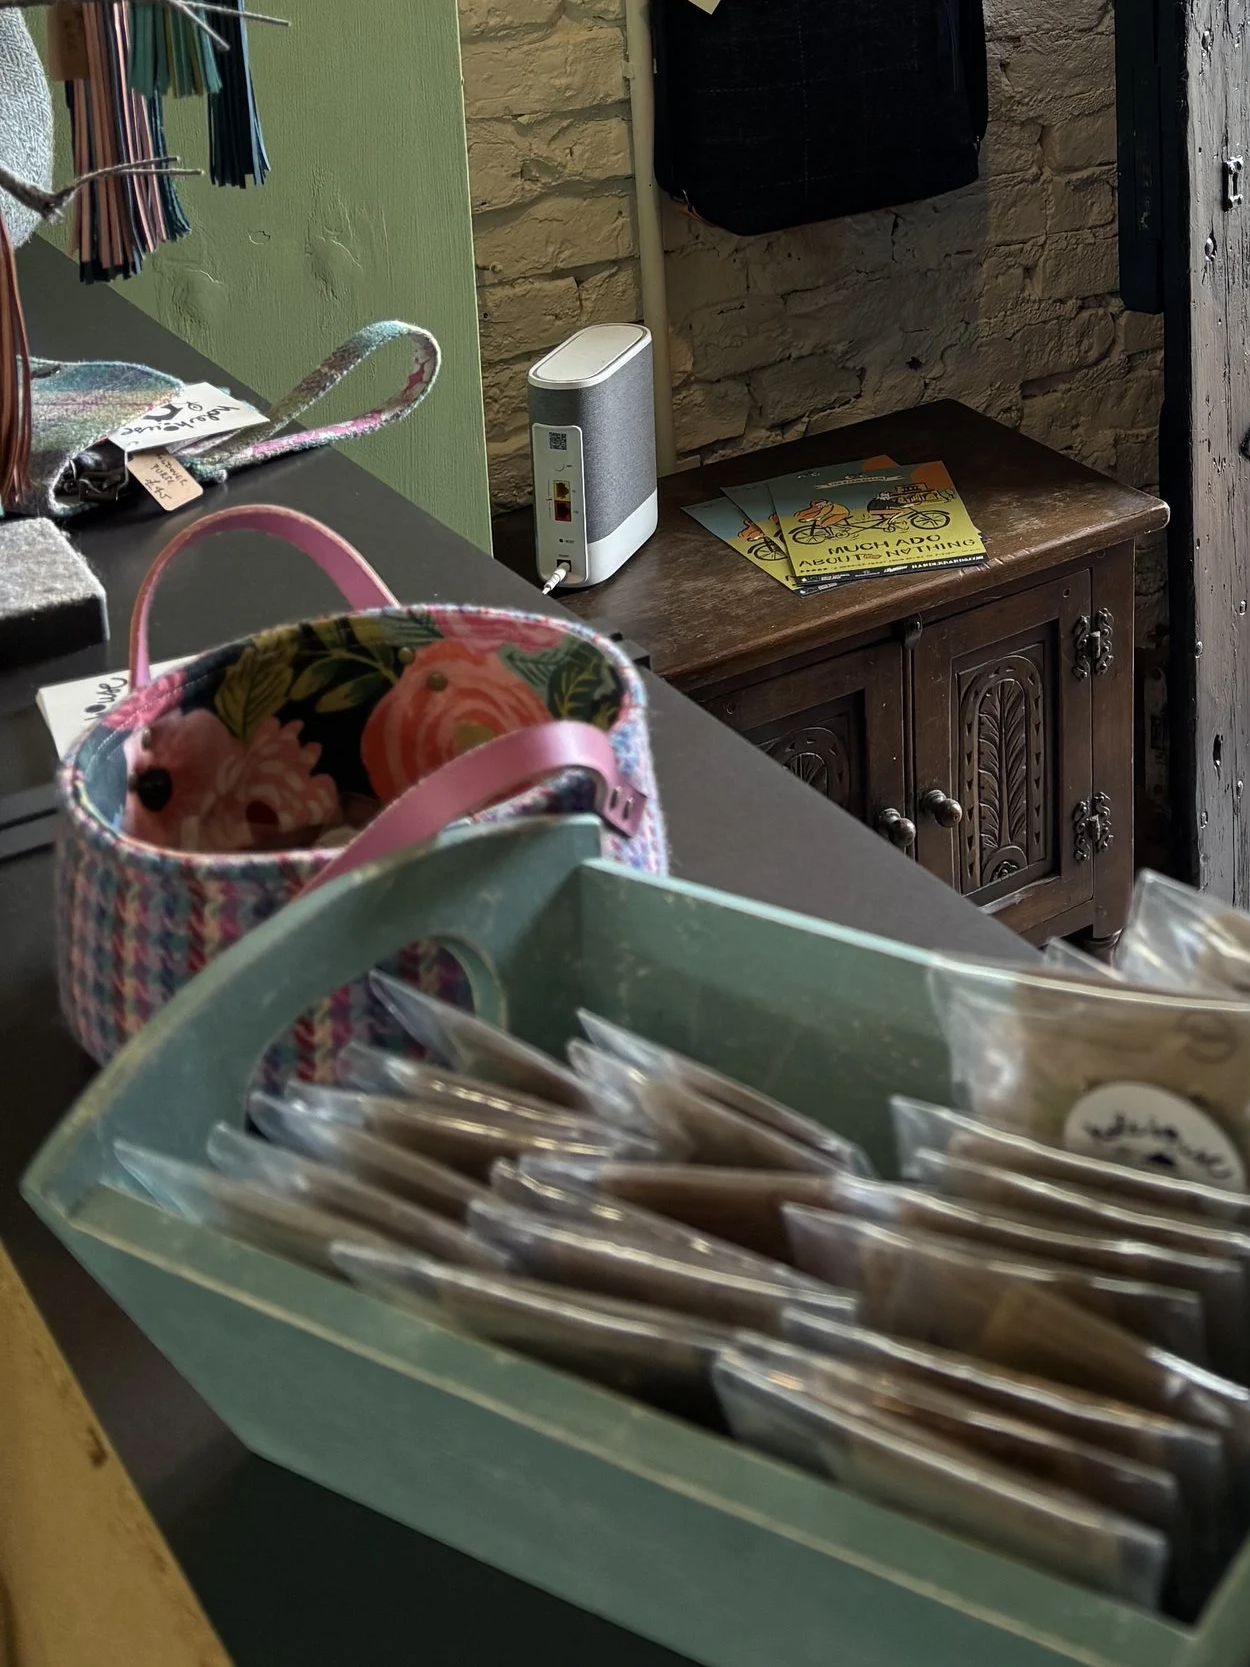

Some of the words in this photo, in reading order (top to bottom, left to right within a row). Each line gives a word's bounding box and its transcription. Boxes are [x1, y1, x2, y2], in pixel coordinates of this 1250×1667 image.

[150, 462, 175, 486] PURSE
[828, 540, 890, 555] MUCH
[895, 534, 942, 547] ADO
[799, 553, 864, 568] ABOUT
